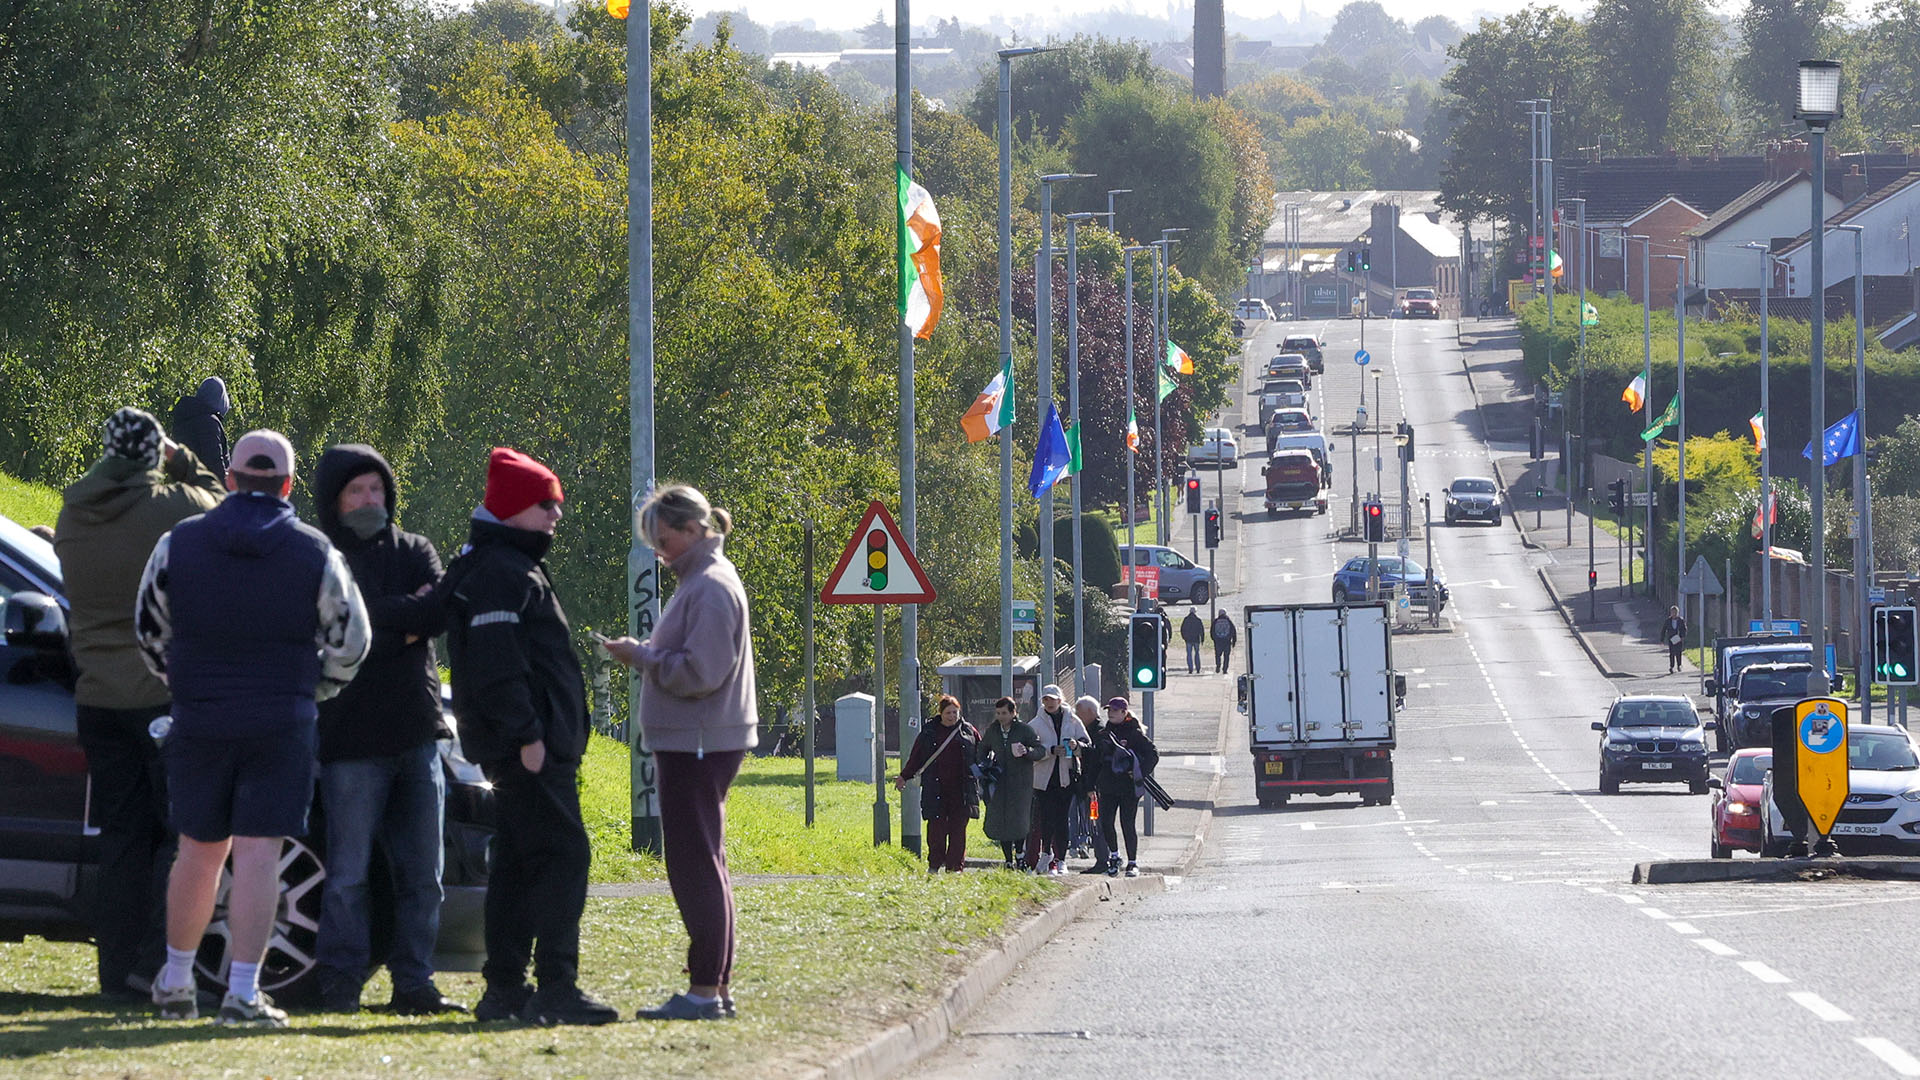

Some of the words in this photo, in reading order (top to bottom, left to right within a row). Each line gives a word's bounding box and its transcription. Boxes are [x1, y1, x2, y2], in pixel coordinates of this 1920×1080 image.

[970, 697, 1000, 706] AMBITIO
[1834, 825, 1852, 833] TJZ
[1854, 826, 1878, 834] 9032
